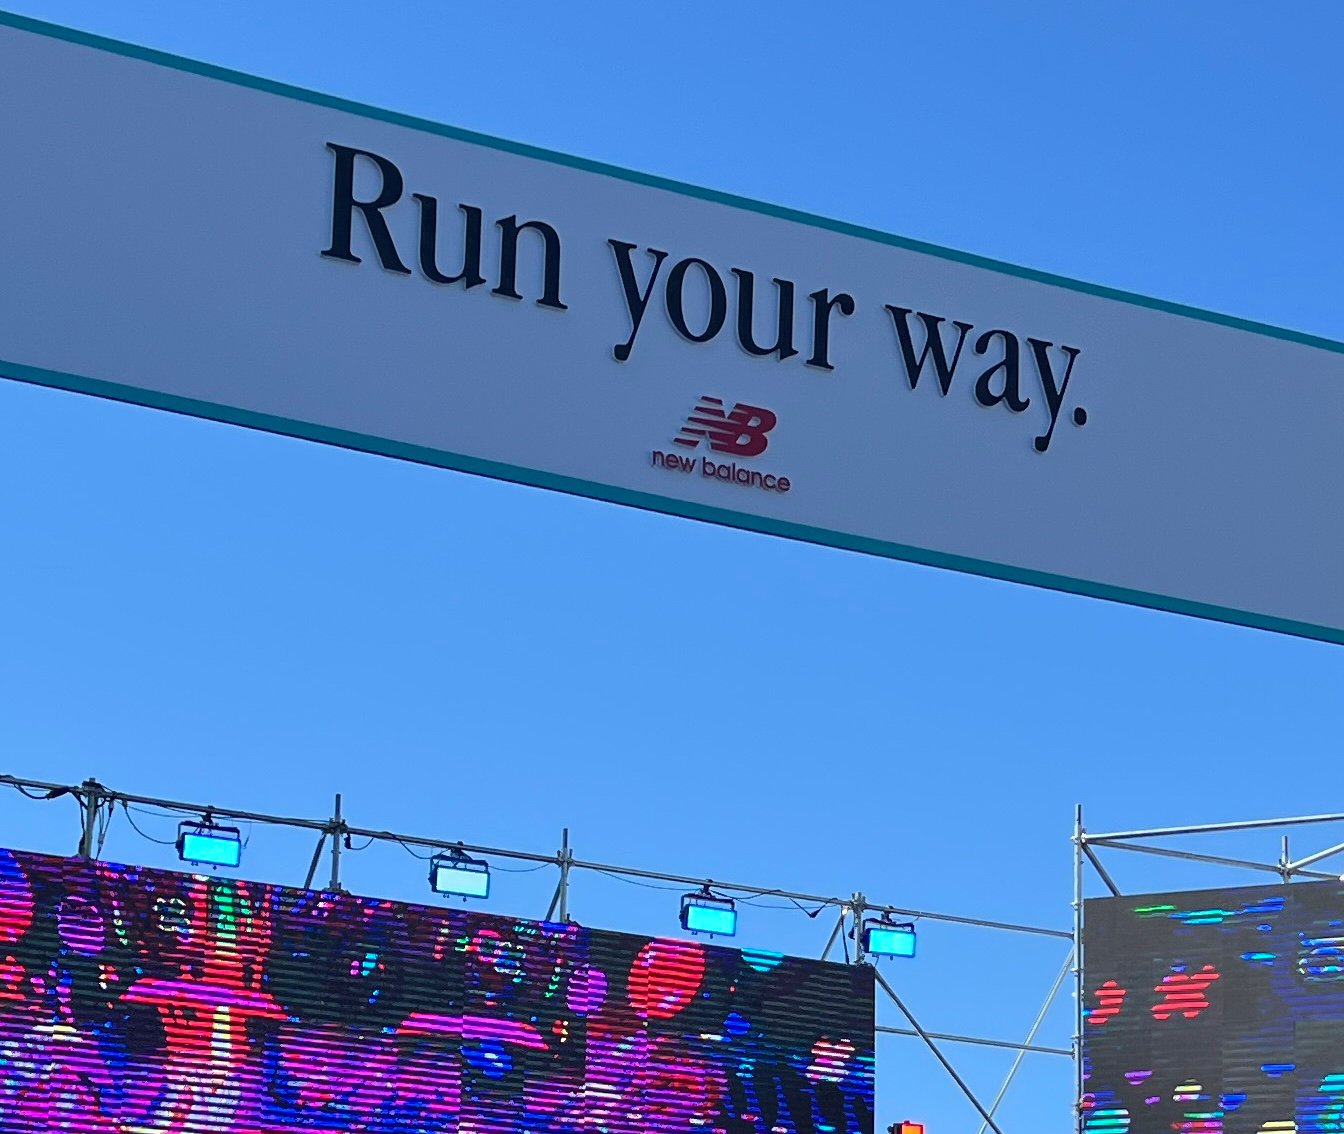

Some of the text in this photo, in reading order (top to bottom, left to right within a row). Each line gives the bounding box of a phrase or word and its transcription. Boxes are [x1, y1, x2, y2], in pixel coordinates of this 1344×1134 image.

[320, 141, 1089, 453] Run your way.
[651, 449, 792, 493] new balance
